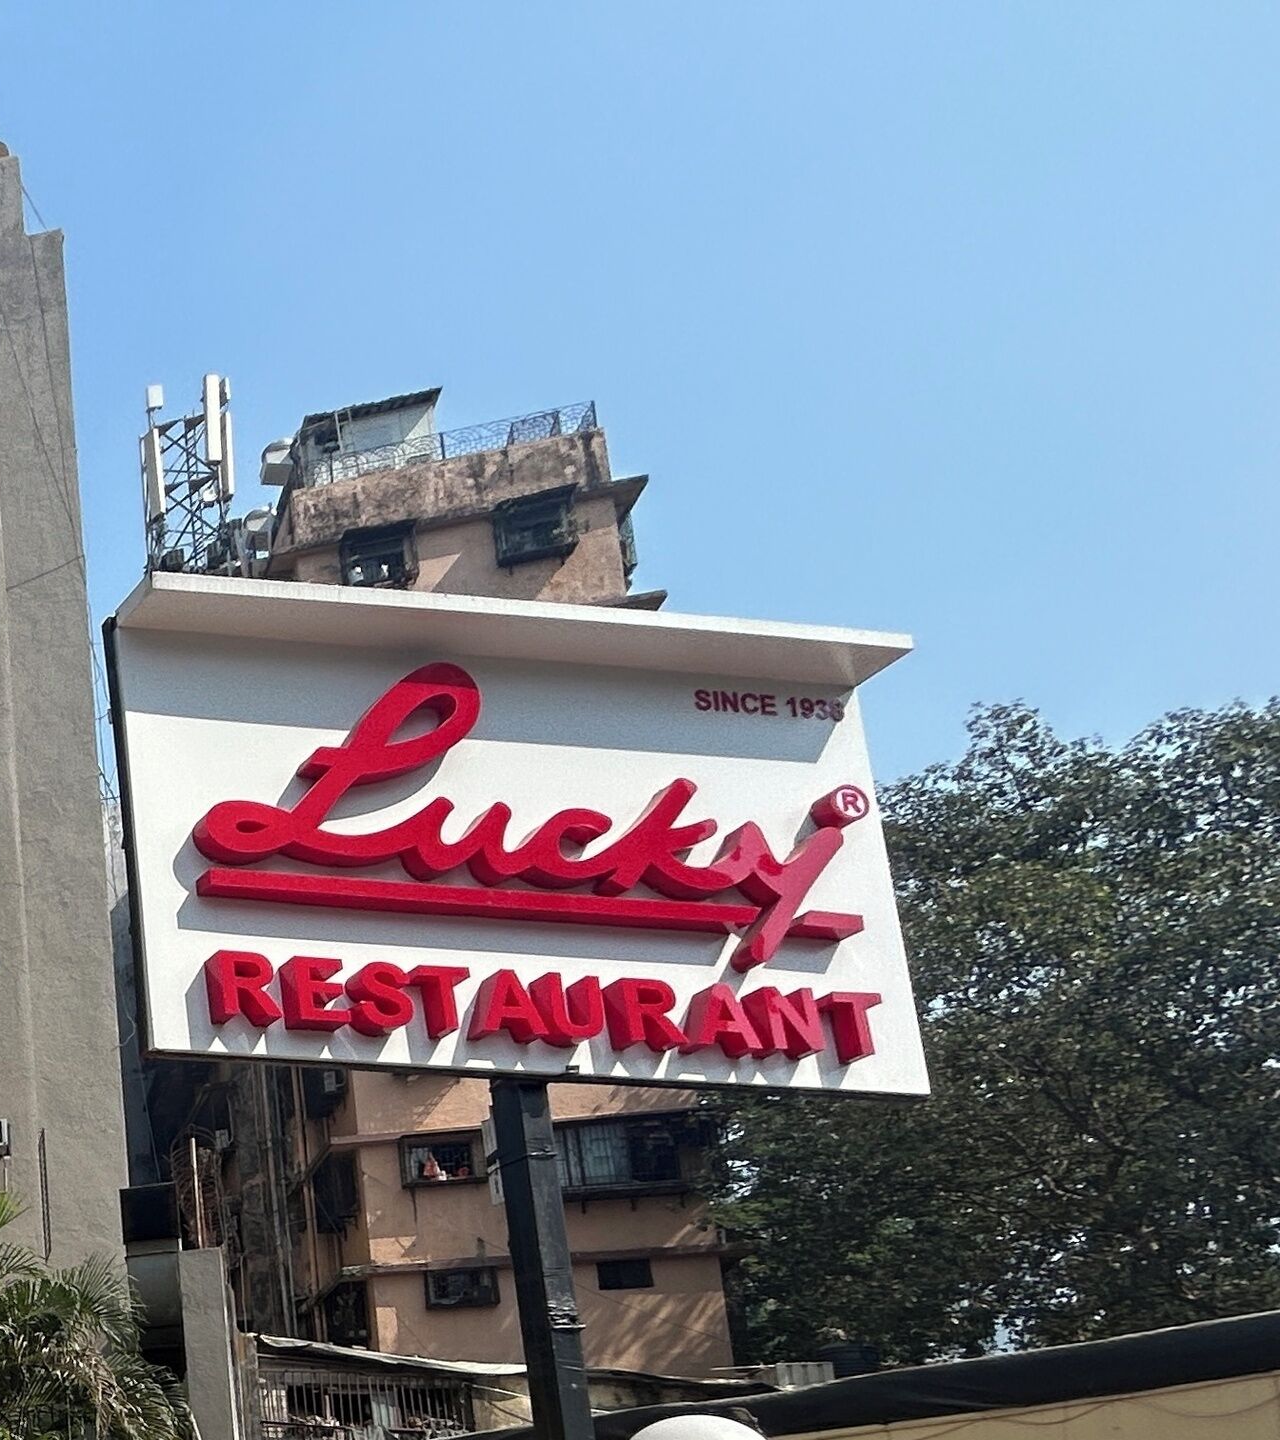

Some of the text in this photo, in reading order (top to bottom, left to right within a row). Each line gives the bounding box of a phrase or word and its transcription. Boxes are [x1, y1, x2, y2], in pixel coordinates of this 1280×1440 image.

[693, 687, 846, 723] SINCE 1938
[192, 662, 846, 972] Lucky
[204, 949, 882, 1064] RESTAURANT
